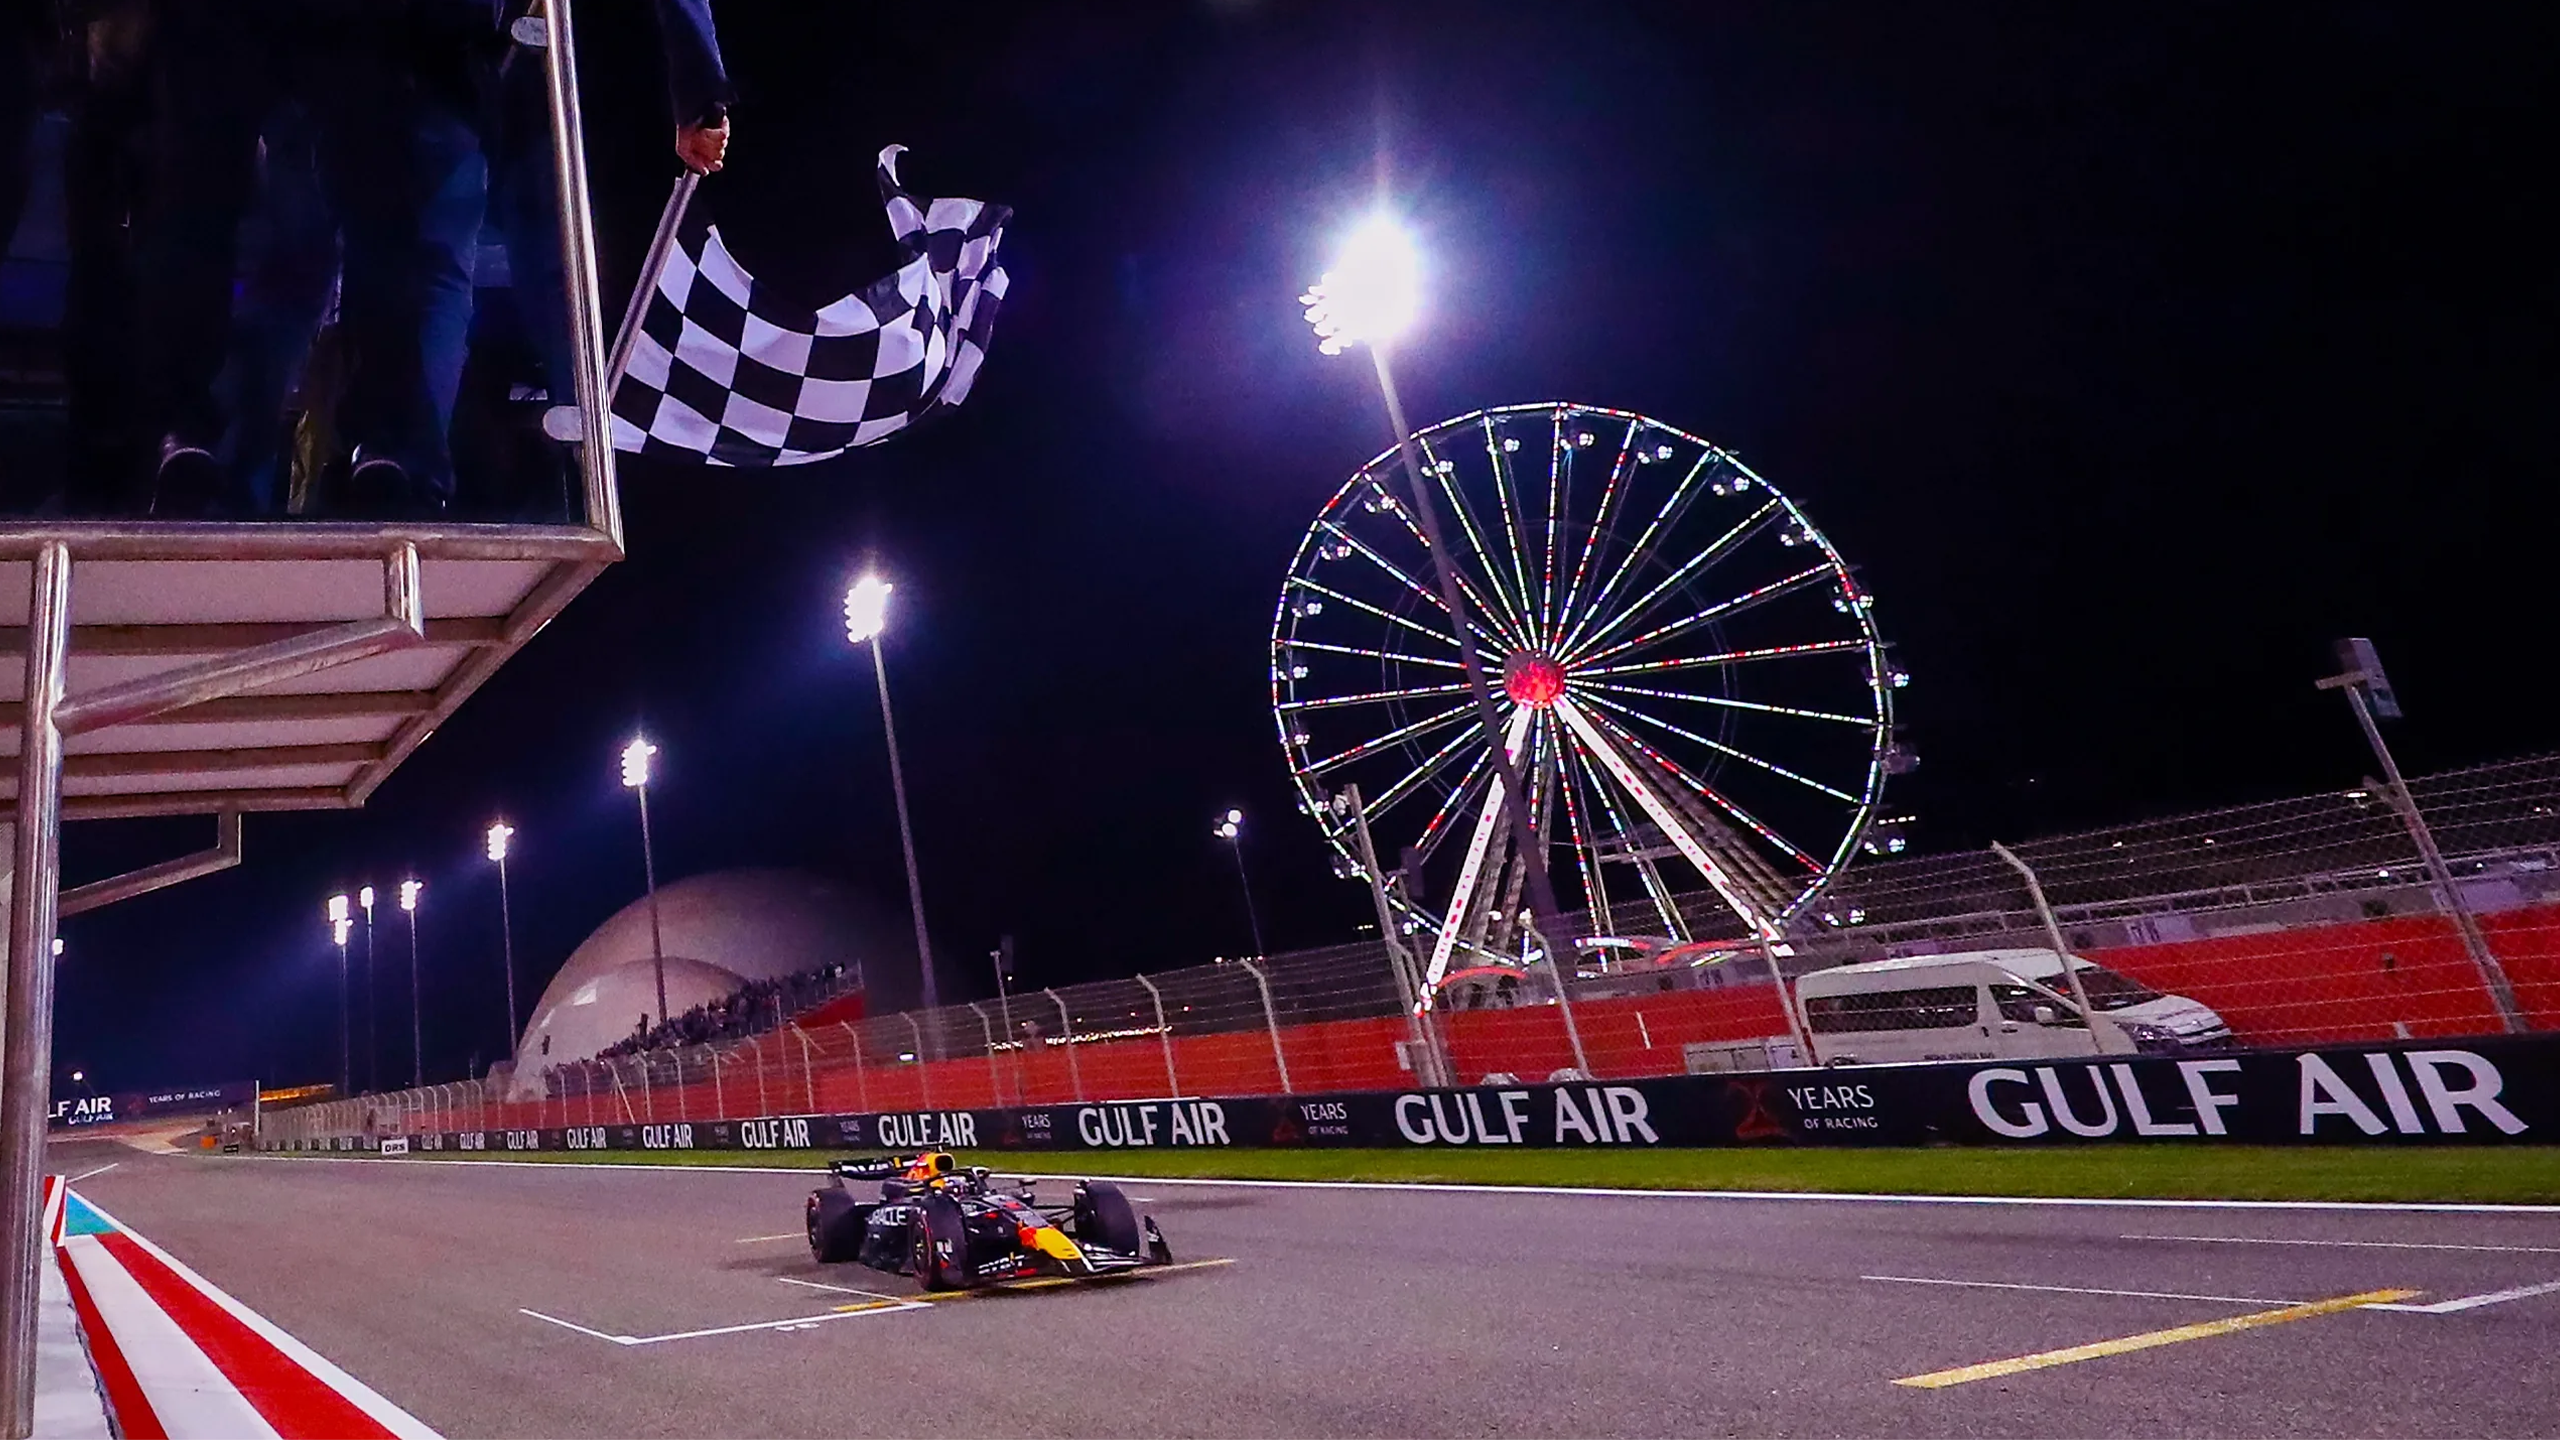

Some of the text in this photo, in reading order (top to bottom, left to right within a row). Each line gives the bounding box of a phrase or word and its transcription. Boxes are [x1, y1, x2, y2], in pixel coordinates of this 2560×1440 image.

[74, 1097, 112, 1115] AIR
[1787, 1085, 1874, 1110] YEARS
[1967, 1050, 2529, 1138] GULF AIR
[1021, 1113, 1051, 1128] YEARS
[1300, 1102, 1347, 1120] YEARS
[1395, 1086, 1660, 1144] GULF AIR
[1804, 1117, 1878, 1129] OF RACING
[642, 1123, 694, 1149] GULF AIR
[741, 1118, 811, 1149] GULF AIR
[878, 1113, 932, 1147] GULF
[938, 1112, 978, 1147] AIR
[1079, 1106, 1158, 1147] GULF
[1171, 1102, 1231, 1146] AIR
[385, 1143, 405, 1152] DRS
[566, 1126, 607, 1149] GULF AIR
